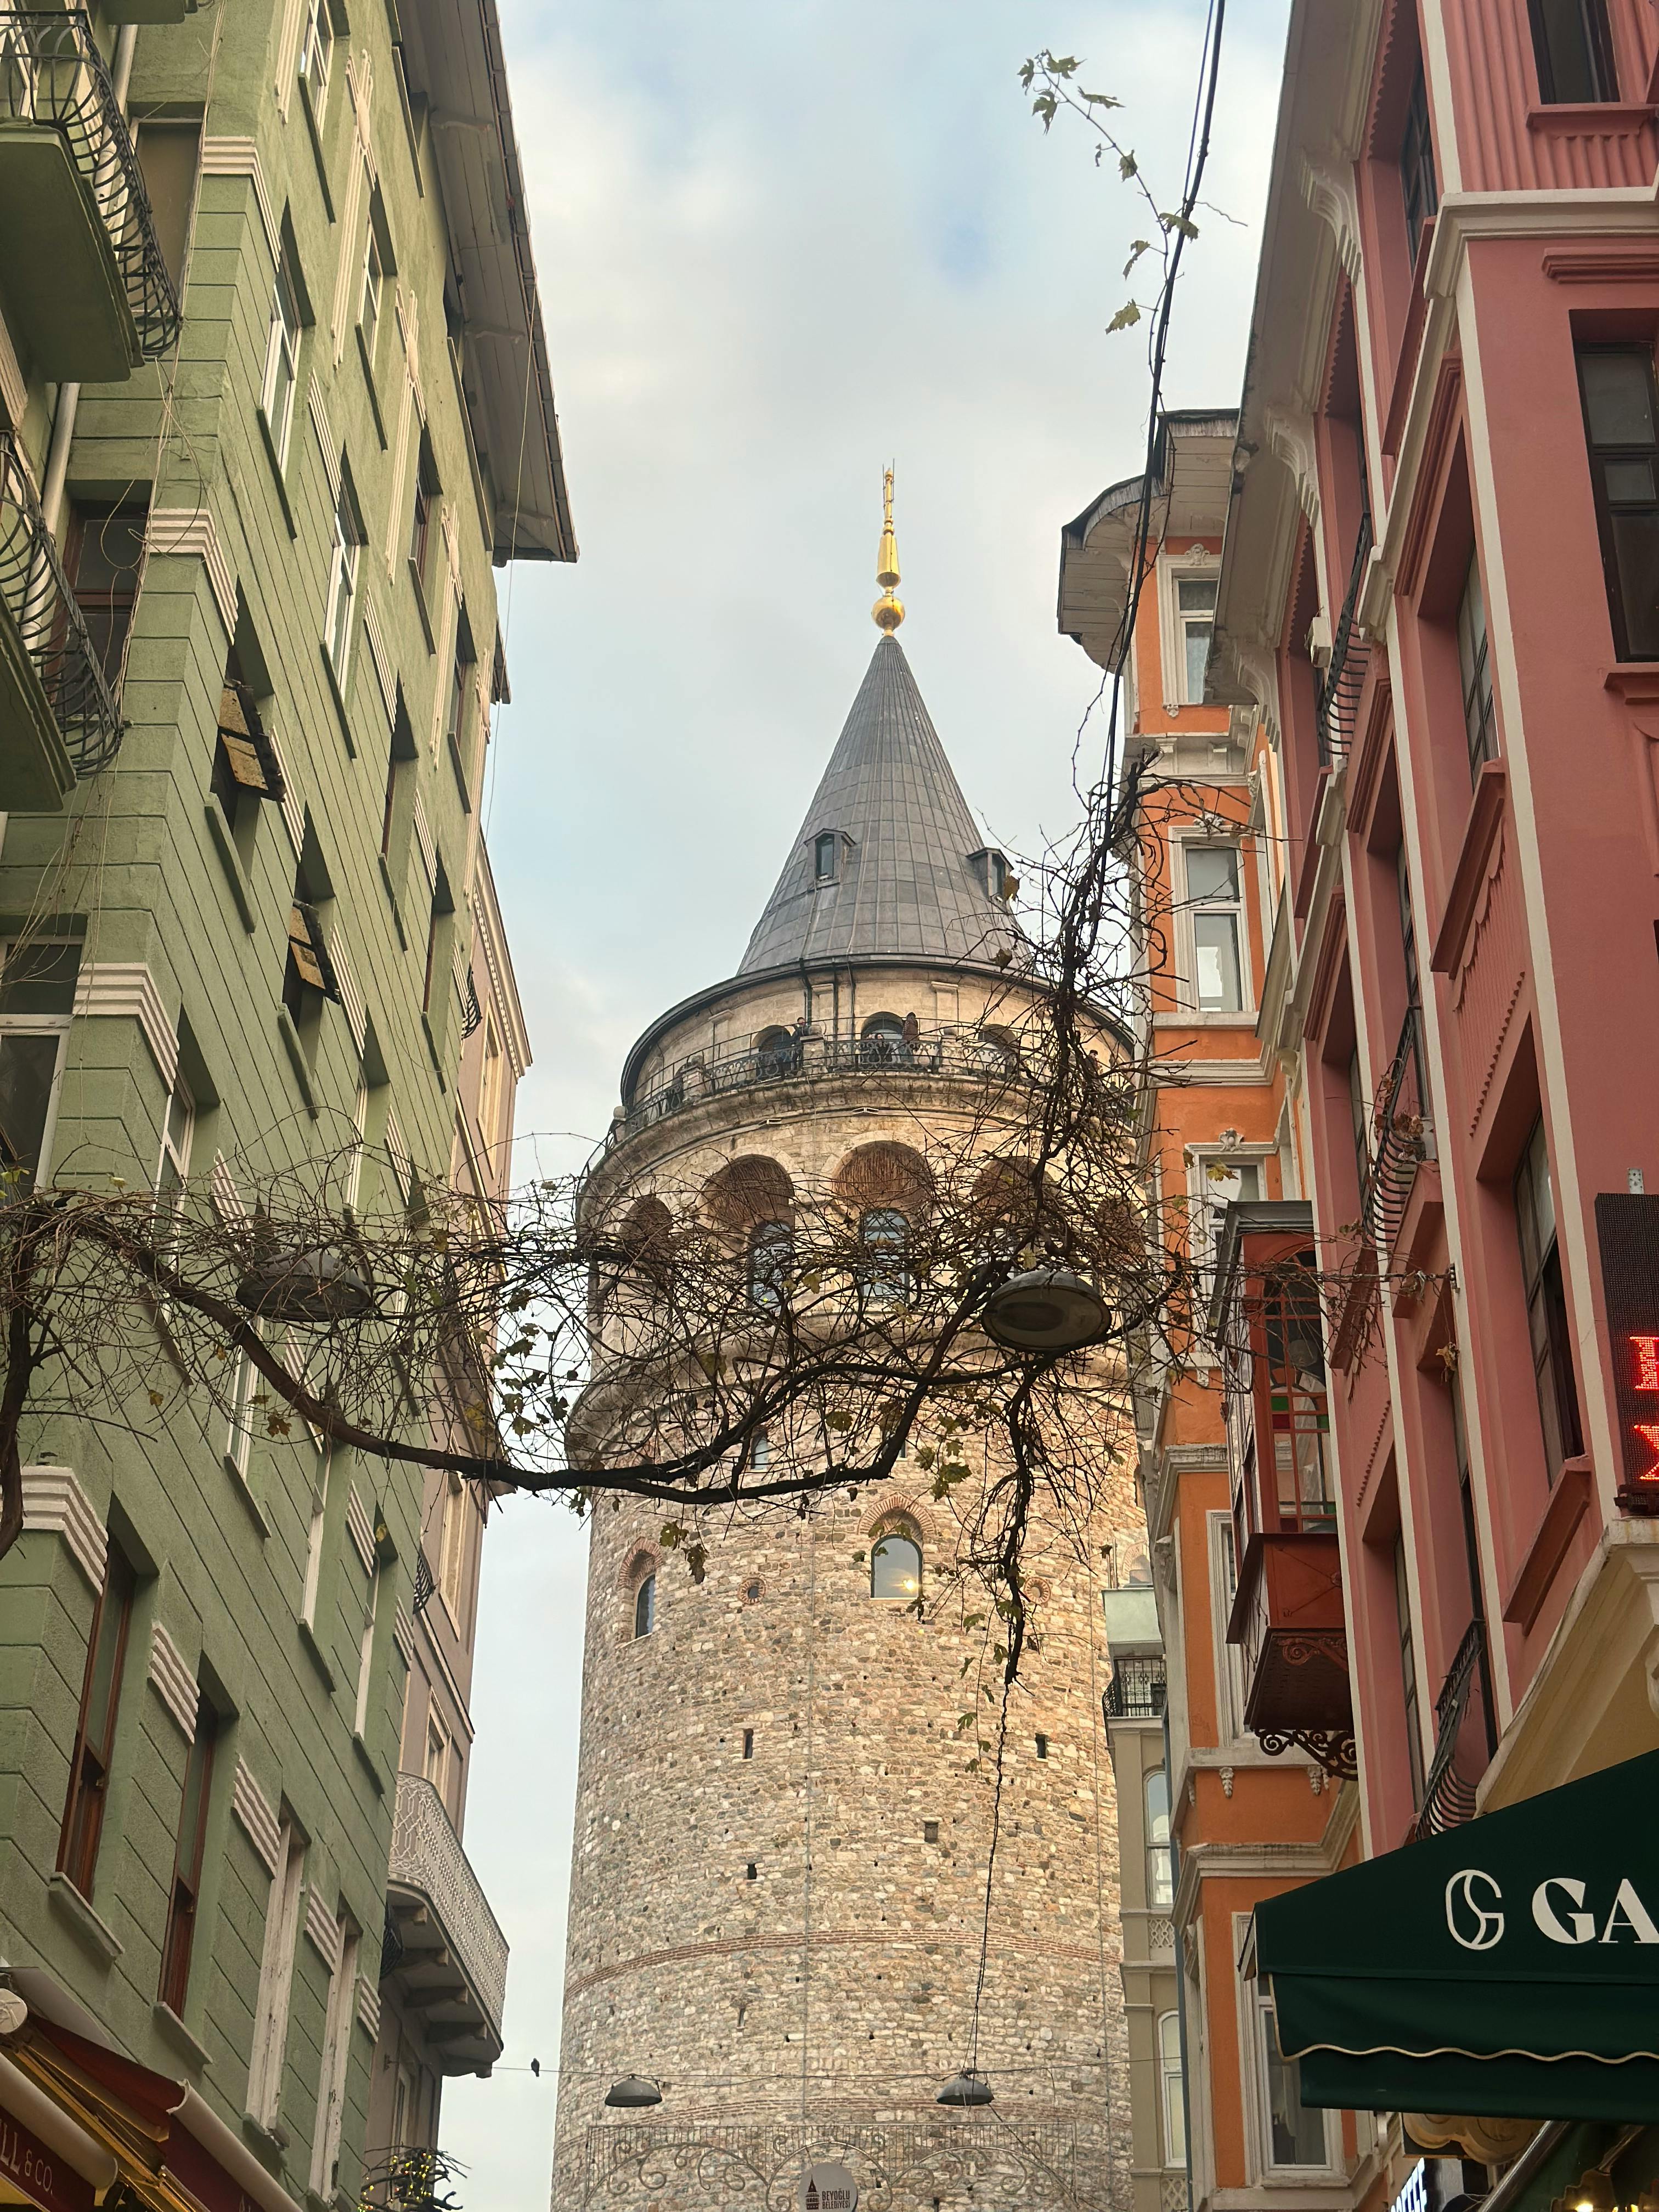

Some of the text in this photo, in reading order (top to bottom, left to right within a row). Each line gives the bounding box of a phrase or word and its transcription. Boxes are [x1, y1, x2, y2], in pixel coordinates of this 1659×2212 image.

[1532, 1877, 1659, 1944] GA
[0, 2119, 21, 2176] LL
[25, 2149, 32, 2177] &
[822, 2188, 850, 2201] BEYOĞLU
[822, 2199, 850, 2209] BELEDİYESİ
